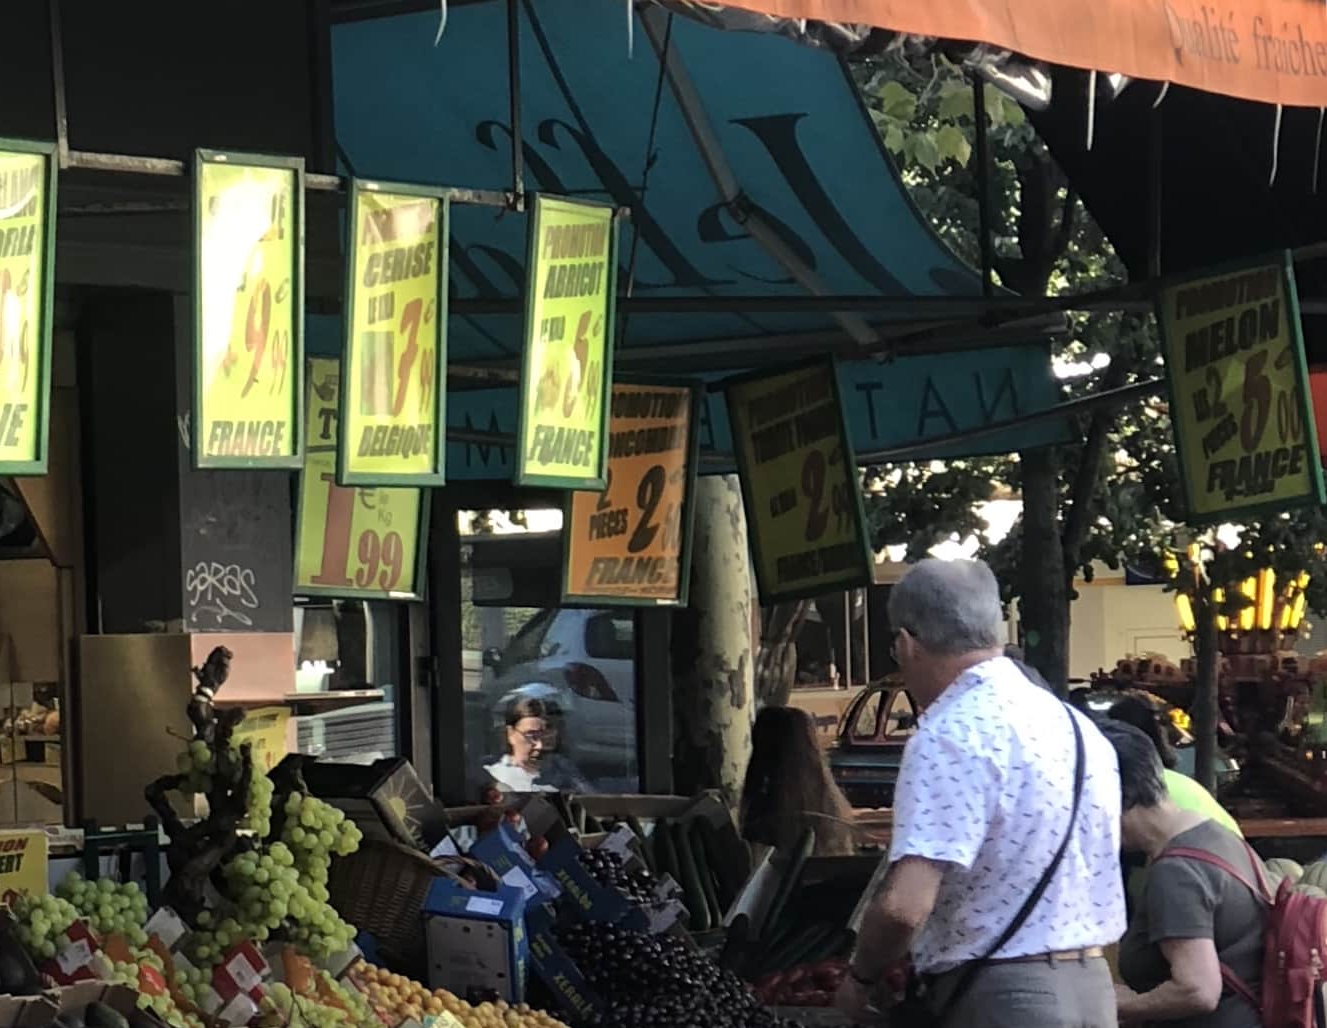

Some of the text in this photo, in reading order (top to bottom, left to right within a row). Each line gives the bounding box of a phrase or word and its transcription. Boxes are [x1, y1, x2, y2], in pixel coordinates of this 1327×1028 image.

[363, 241, 436, 288] CERISE
[543, 262, 604, 299] ABRICOT
[1185, 299, 1280, 372] MELON
[208, 420, 286, 456] FRANCE
[358, 425, 433, 460] BELGIQUE
[527, 424, 595, 466] FRANCE
[627, 465, 666, 553] 2
[355, 529, 403, 591] 99
